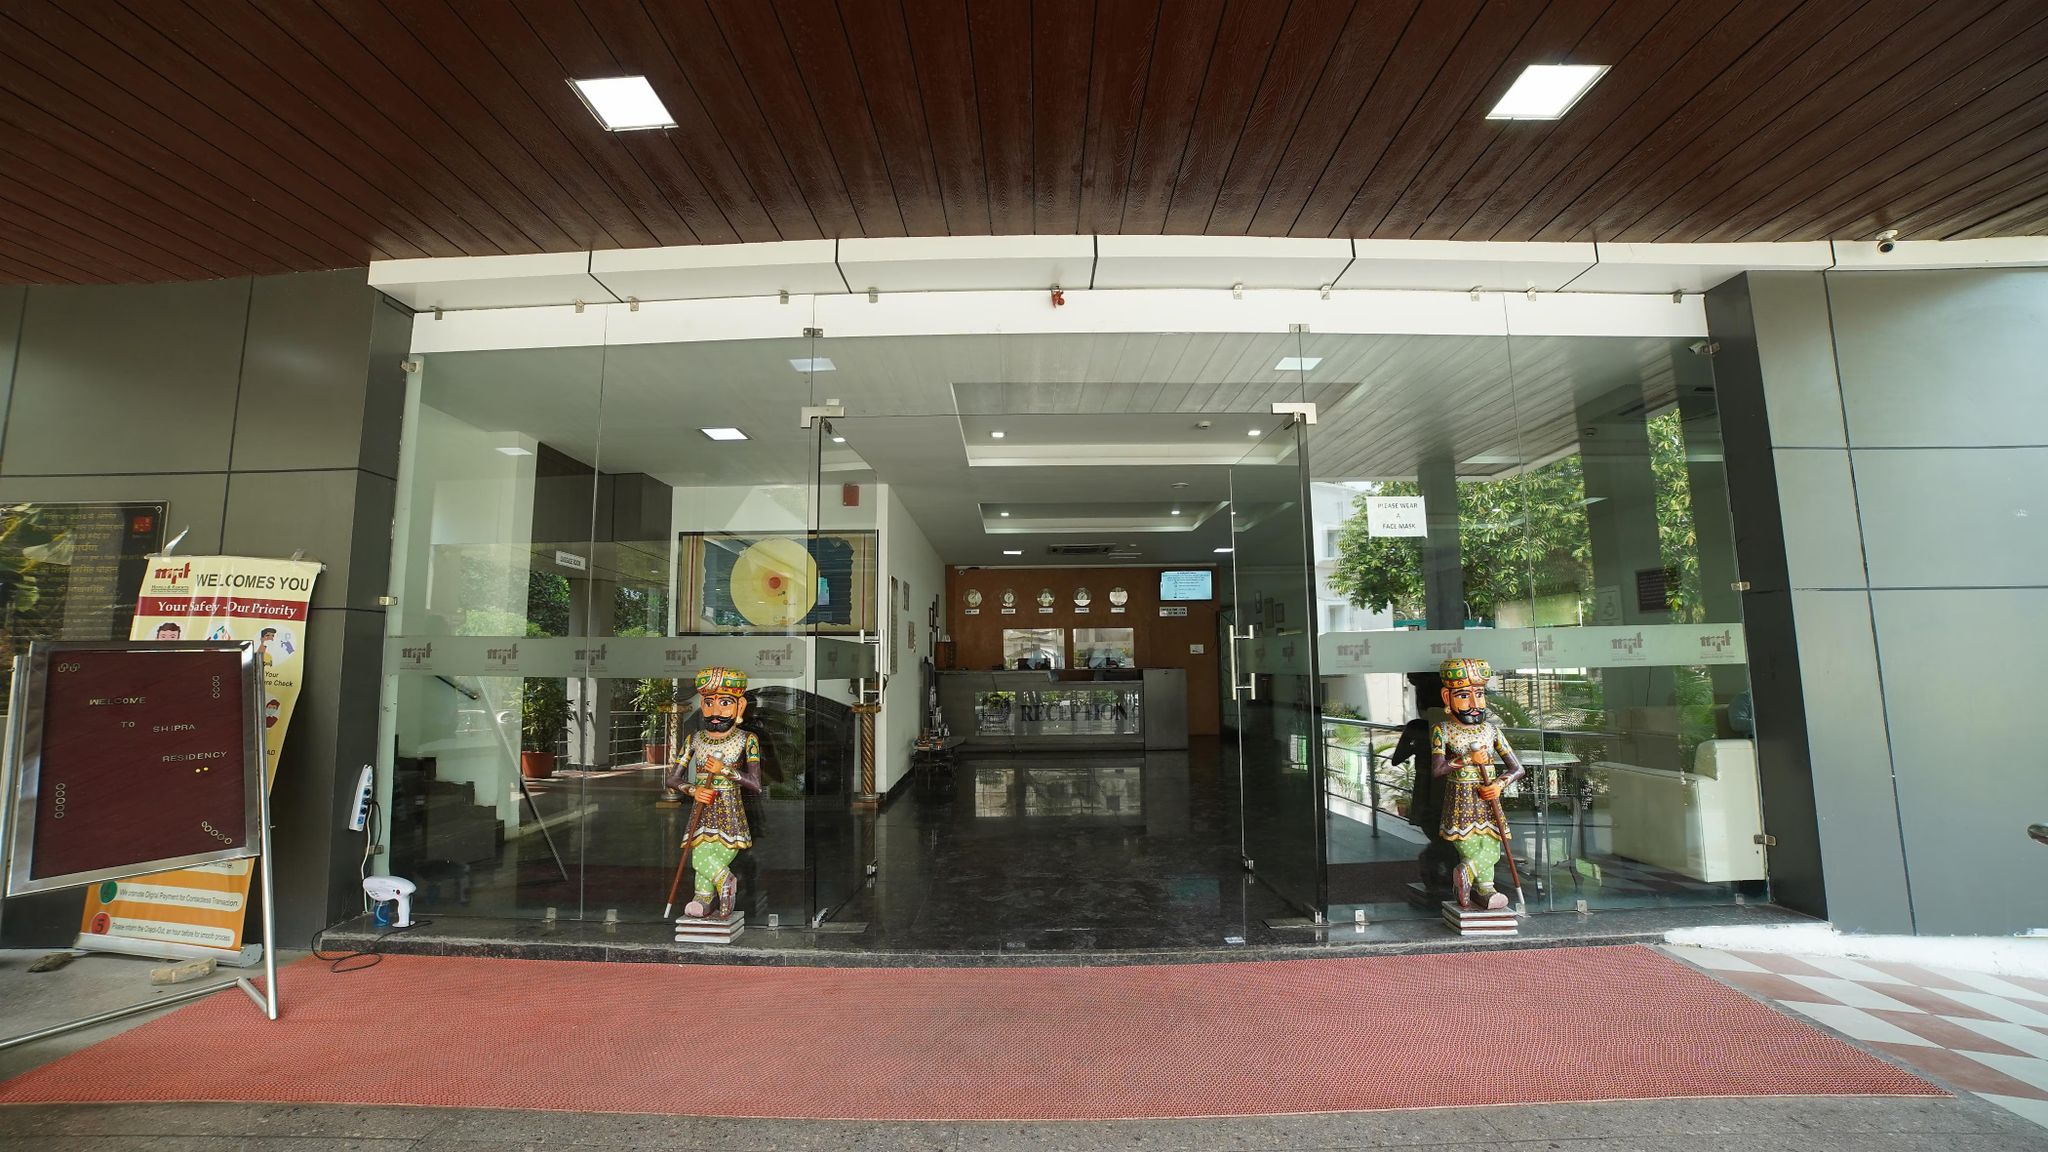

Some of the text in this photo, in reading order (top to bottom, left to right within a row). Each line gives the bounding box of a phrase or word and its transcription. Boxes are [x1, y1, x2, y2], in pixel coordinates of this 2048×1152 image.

[196, 574, 309, 591] WELCOMES YOU
[158, 601, 188, 611] Your
[251, 602, 297, 619] Priority
[89, 697, 146, 705] WELCOME
[1020, 702, 1128, 722] RECEPTION
[153, 724, 196, 732] SHIPRA
[162, 751, 227, 762] RESIDENCY
